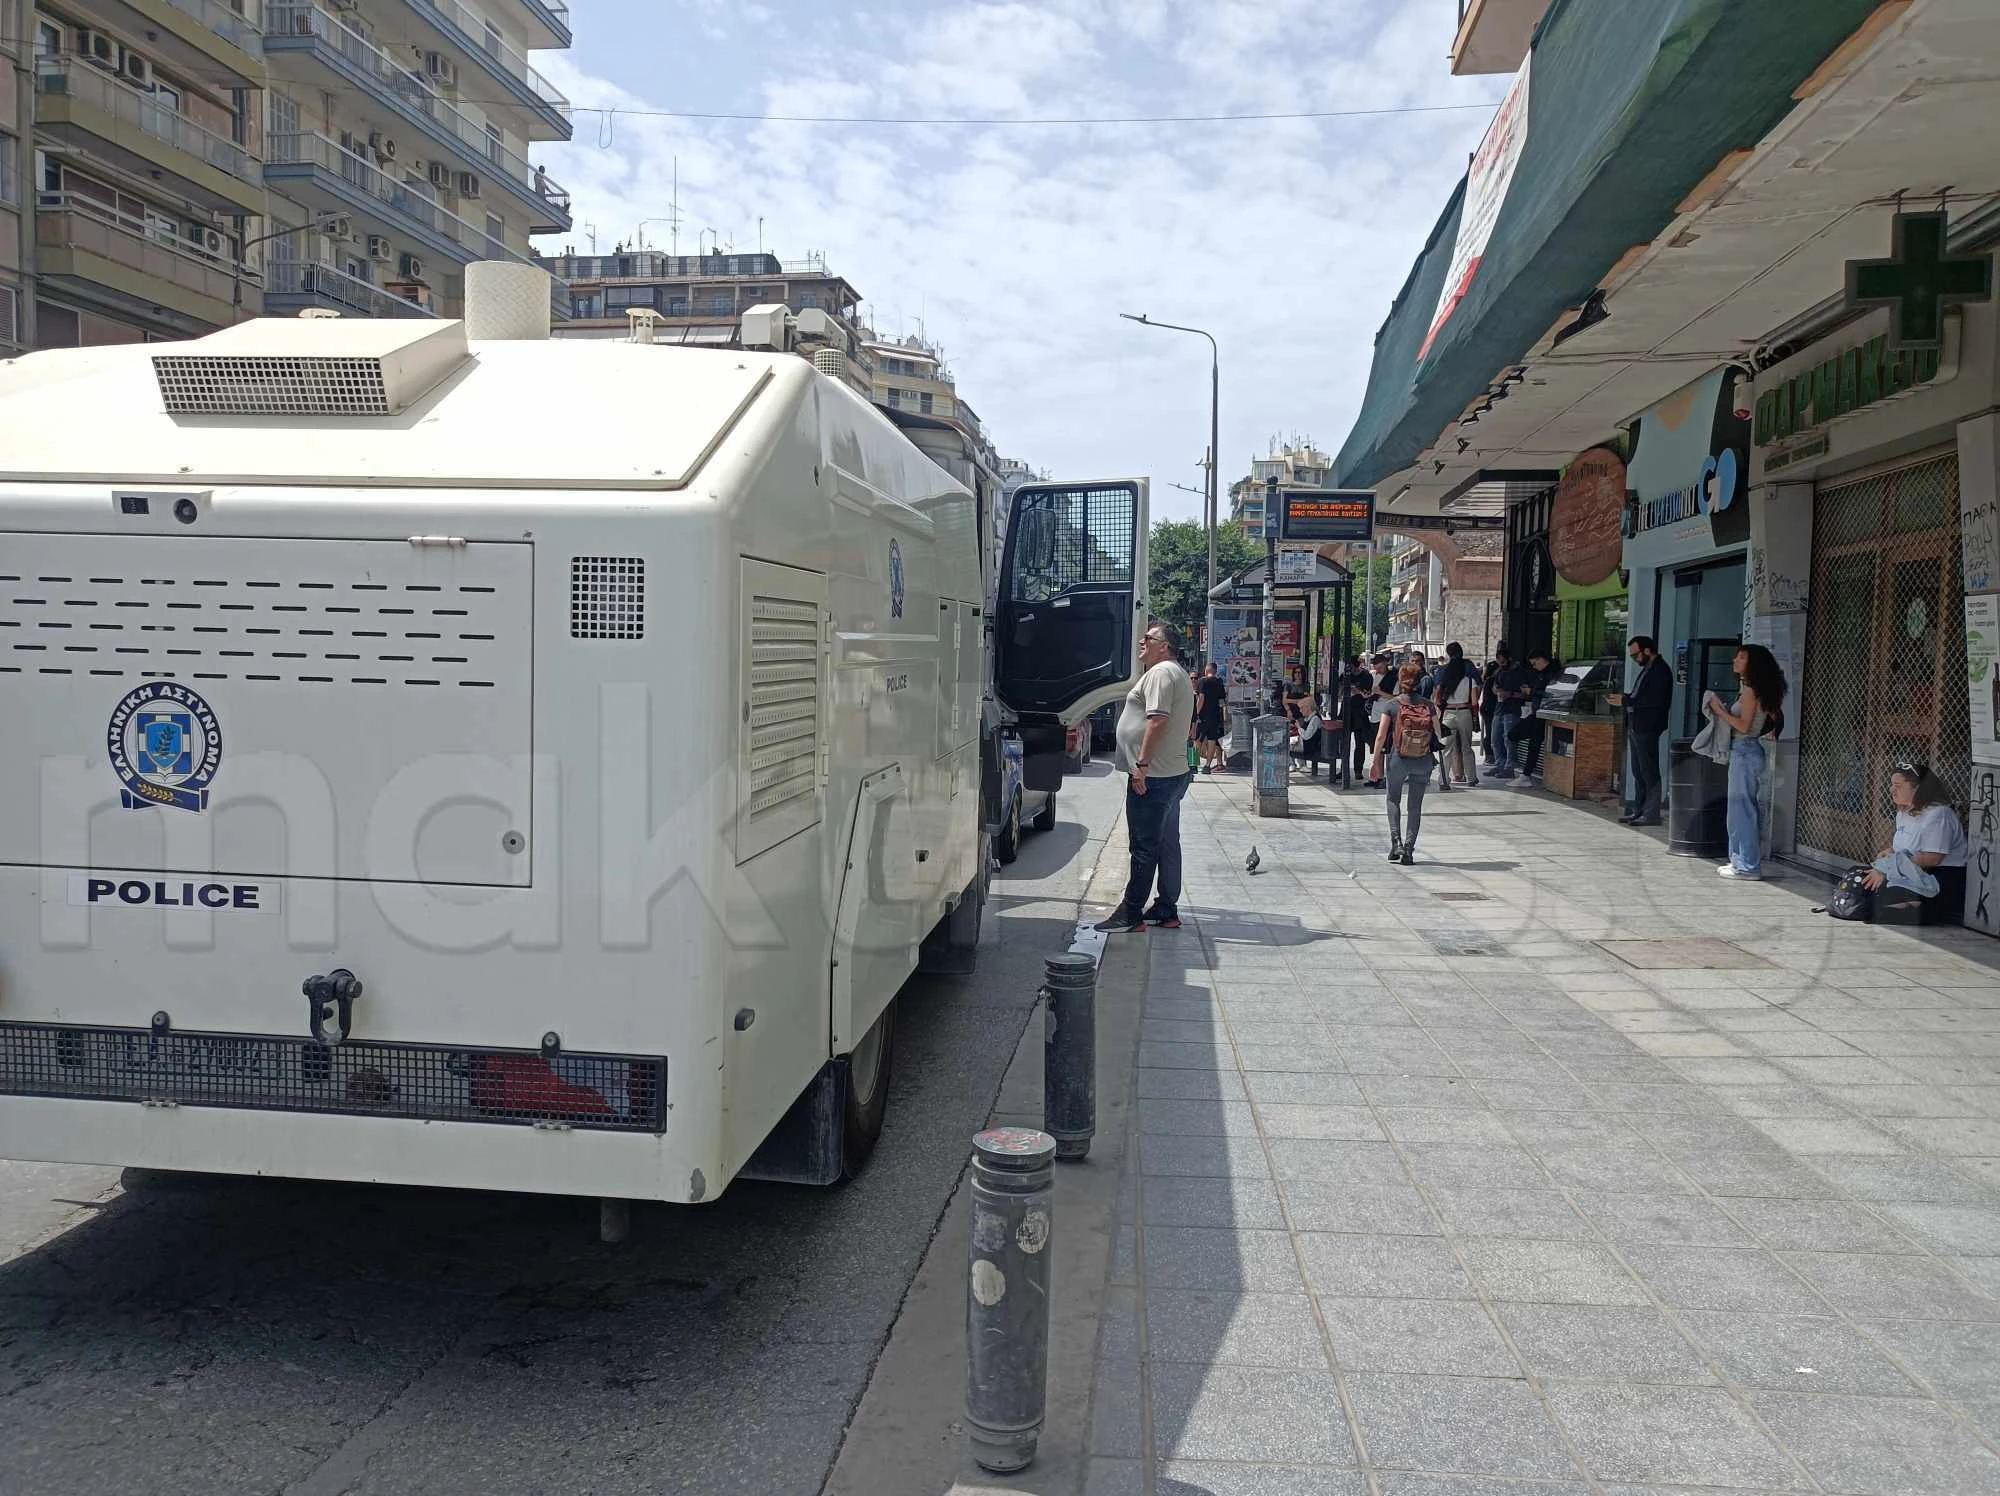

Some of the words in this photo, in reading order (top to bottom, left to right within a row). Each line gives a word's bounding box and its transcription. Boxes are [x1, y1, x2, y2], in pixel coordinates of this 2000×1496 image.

[887, 674, 907, 693] POLICE
[110, 687, 154, 782] ΕΛΛΗΝΙΚΗ
[159, 685, 219, 782] ΑΣΤΥΝΟΜΙΑ
[87, 878, 260, 909] POLICE
